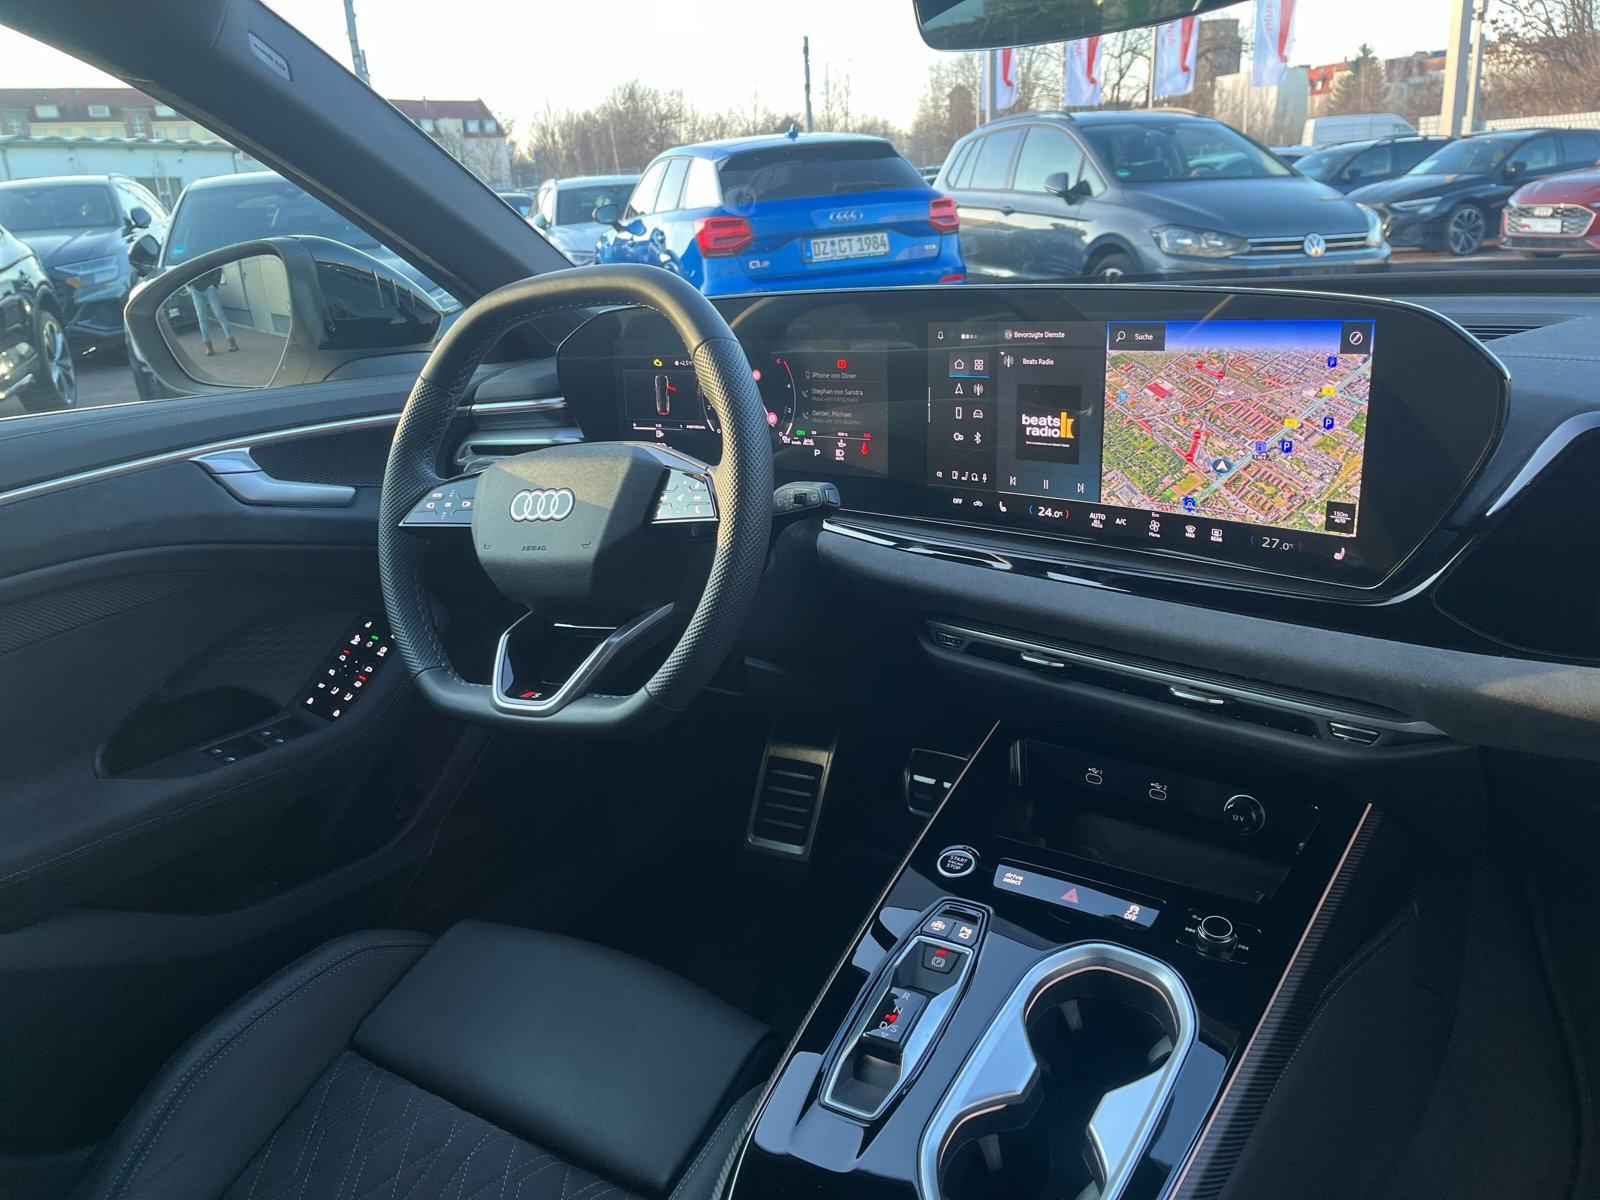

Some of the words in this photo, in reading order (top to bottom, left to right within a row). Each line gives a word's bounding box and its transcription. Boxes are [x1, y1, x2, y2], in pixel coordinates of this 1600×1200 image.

[811, 239, 828, 257] DZ
[837, 236, 853, 254] CT
[858, 234, 887, 251] 1984
[1013, 331, 1044, 340] Bevorzugte
[1134, 333, 1154, 341] Suche
[811, 388, 834, 396] Stephan
[831, 410, 853, 418] Michael
[1021, 413, 1061, 427] beats
[1025, 425, 1061, 438] radio
[813, 449, 821, 457] P
[952, 497, 963, 505] OFF
[1089, 512, 1106, 520] AUTO
[1115, 518, 1127, 526] A/C
[950, 855, 968, 863] START
[1005, 872, 1024, 881] drive
[1002, 877, 1022, 886] select
[1124, 912, 1138, 921] OFF
[902, 992, 911, 1000] R
[893, 1006, 903, 1014] N
